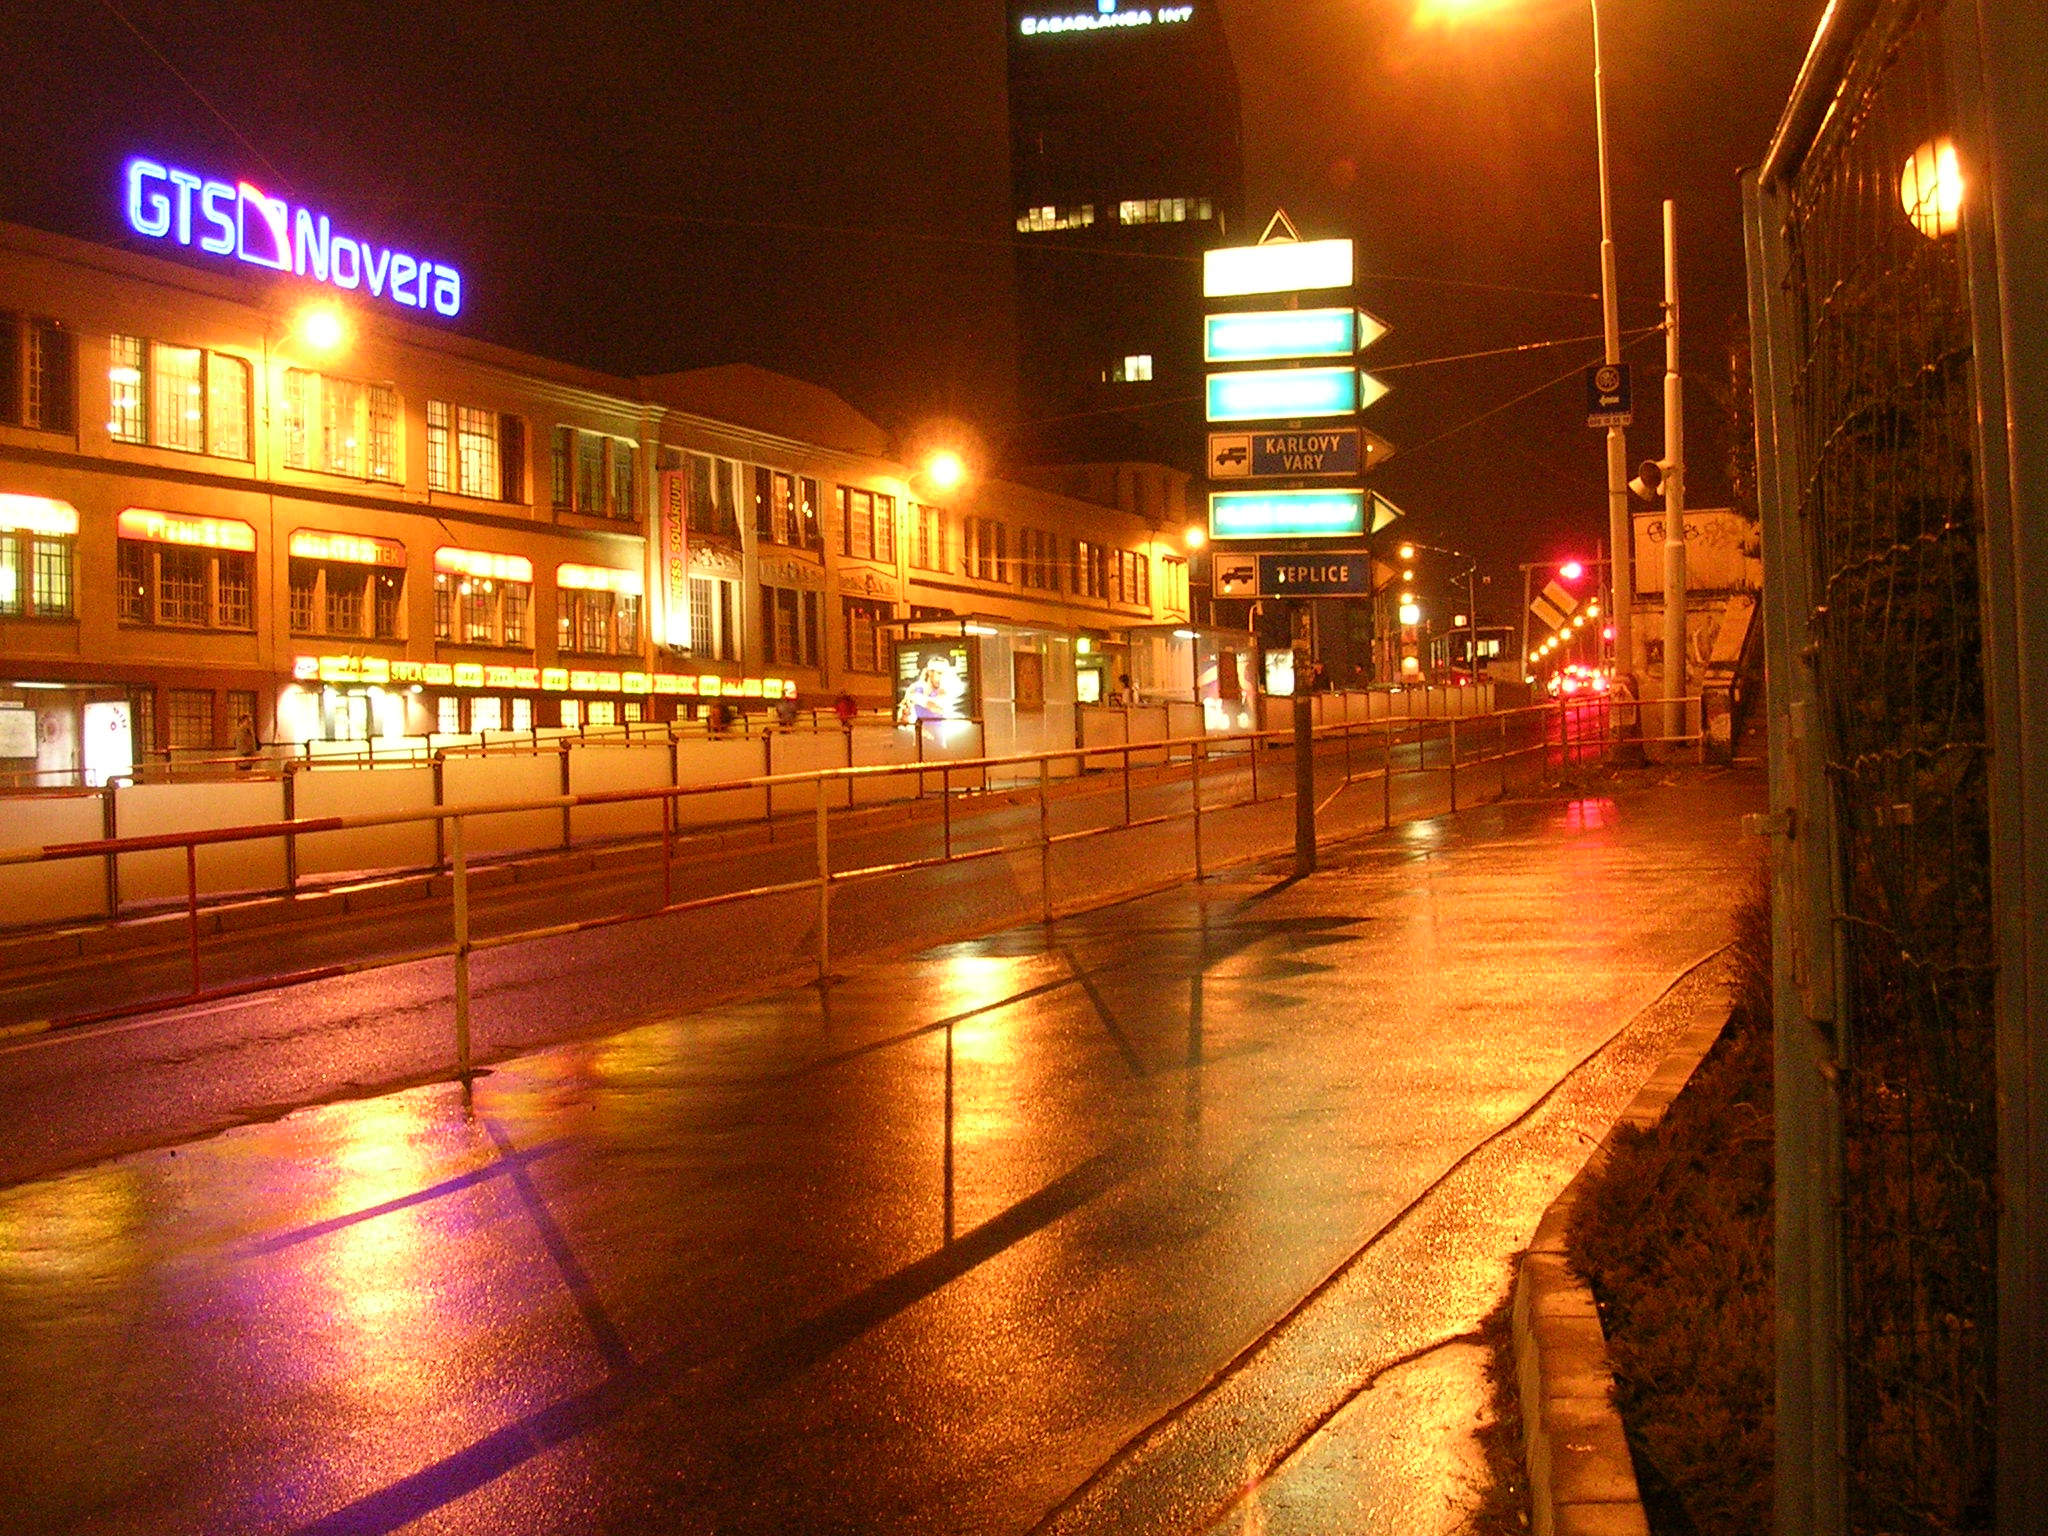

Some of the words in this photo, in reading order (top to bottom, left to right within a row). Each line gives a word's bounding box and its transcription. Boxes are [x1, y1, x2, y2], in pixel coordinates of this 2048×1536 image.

[127, 158, 236, 255] GTS
[294, 207, 463, 318] Novera
[1265, 434, 1341, 454] KARLOVY
[1282, 453, 1325, 471] VARY
[667, 477, 684, 552] SOLÁRIUM
[147, 517, 230, 546] FITNESS
[1276, 565, 1350, 585] TEPLICE
